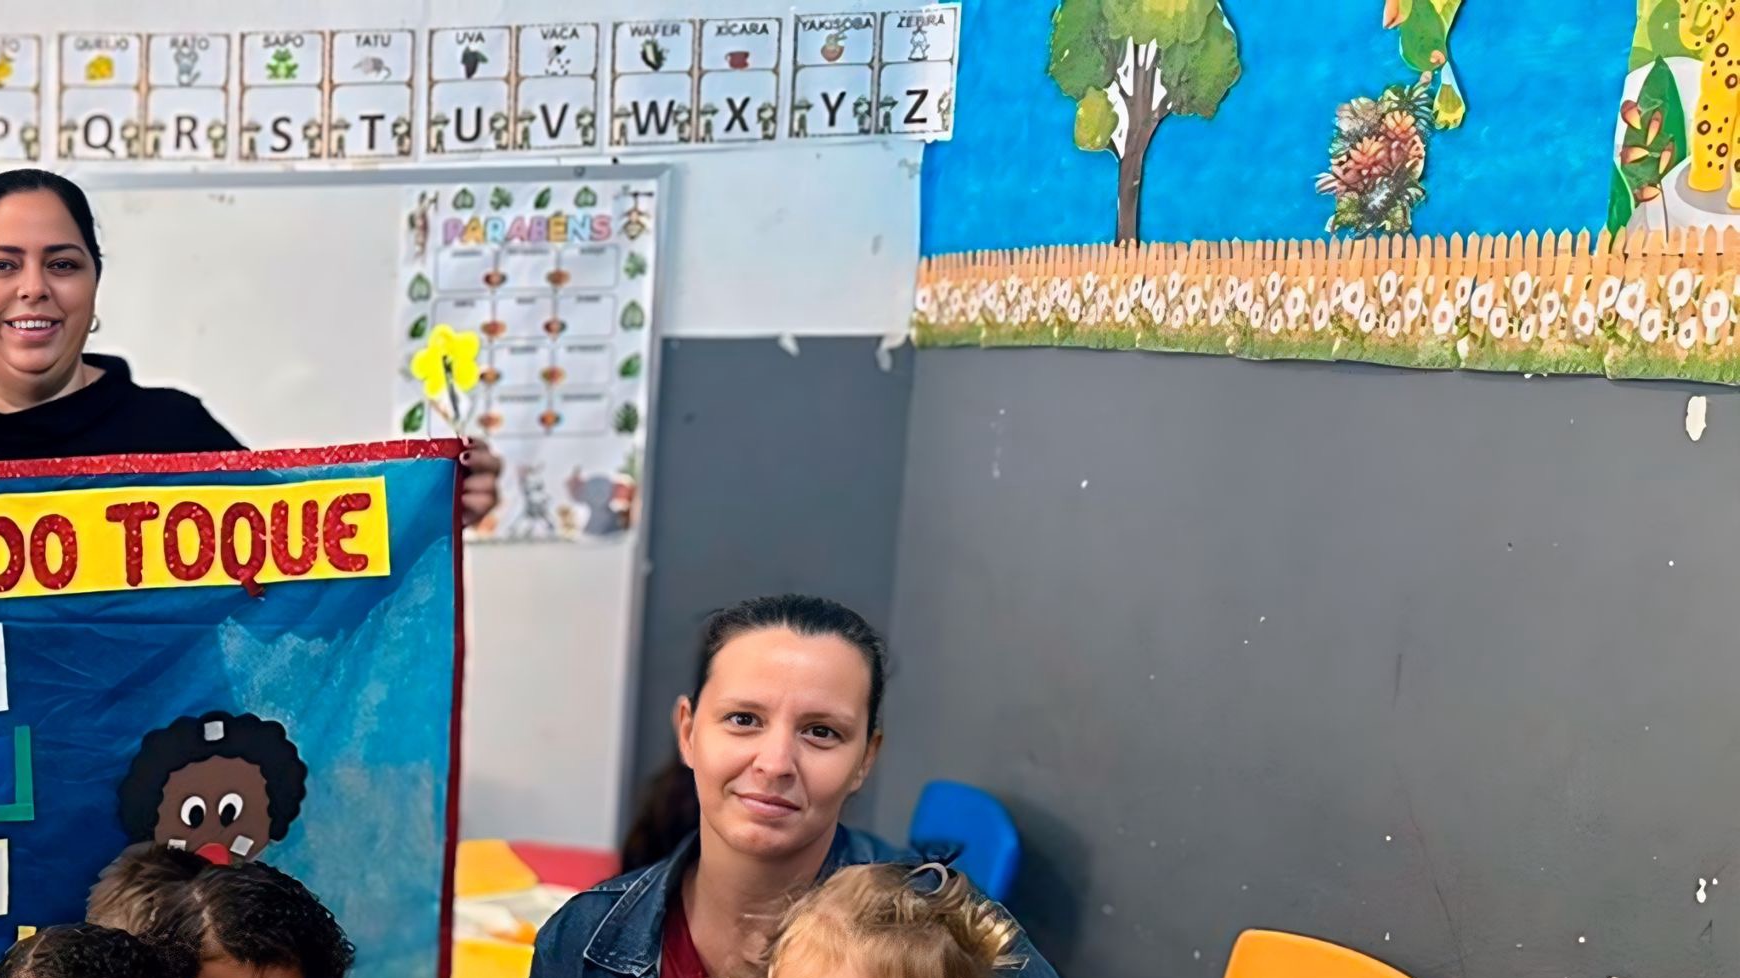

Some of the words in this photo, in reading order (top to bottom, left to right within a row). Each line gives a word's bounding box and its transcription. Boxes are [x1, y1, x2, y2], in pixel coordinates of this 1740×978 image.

[456, 31, 485, 45] UVA
[540, 27, 580, 41] VACA
[629, 22, 681, 38] WAFER
[714, 19, 769, 37] XÍCARA
[896, 13, 945, 29] ZEBRA
[74, 37, 128, 51] QUEIJO
[170, 37, 210, 51] RATO
[262, 34, 304, 49] SAPO
[355, 34, 392, 48] TATU
[539, 104, 570, 139] V
[632, 100, 674, 136] W
[723, 97, 750, 133] X
[820, 92, 847, 128] Y
[903, 89, 929, 125] Z
[83, 115, 115, 155] Q
[175, 116, 198, 150] R
[270, 117, 293, 153] S
[359, 115, 385, 150] T
[455, 107, 482, 143] U
[443, 211, 612, 245] PARABÉNS
[105, 493, 371, 597] TOQUE
